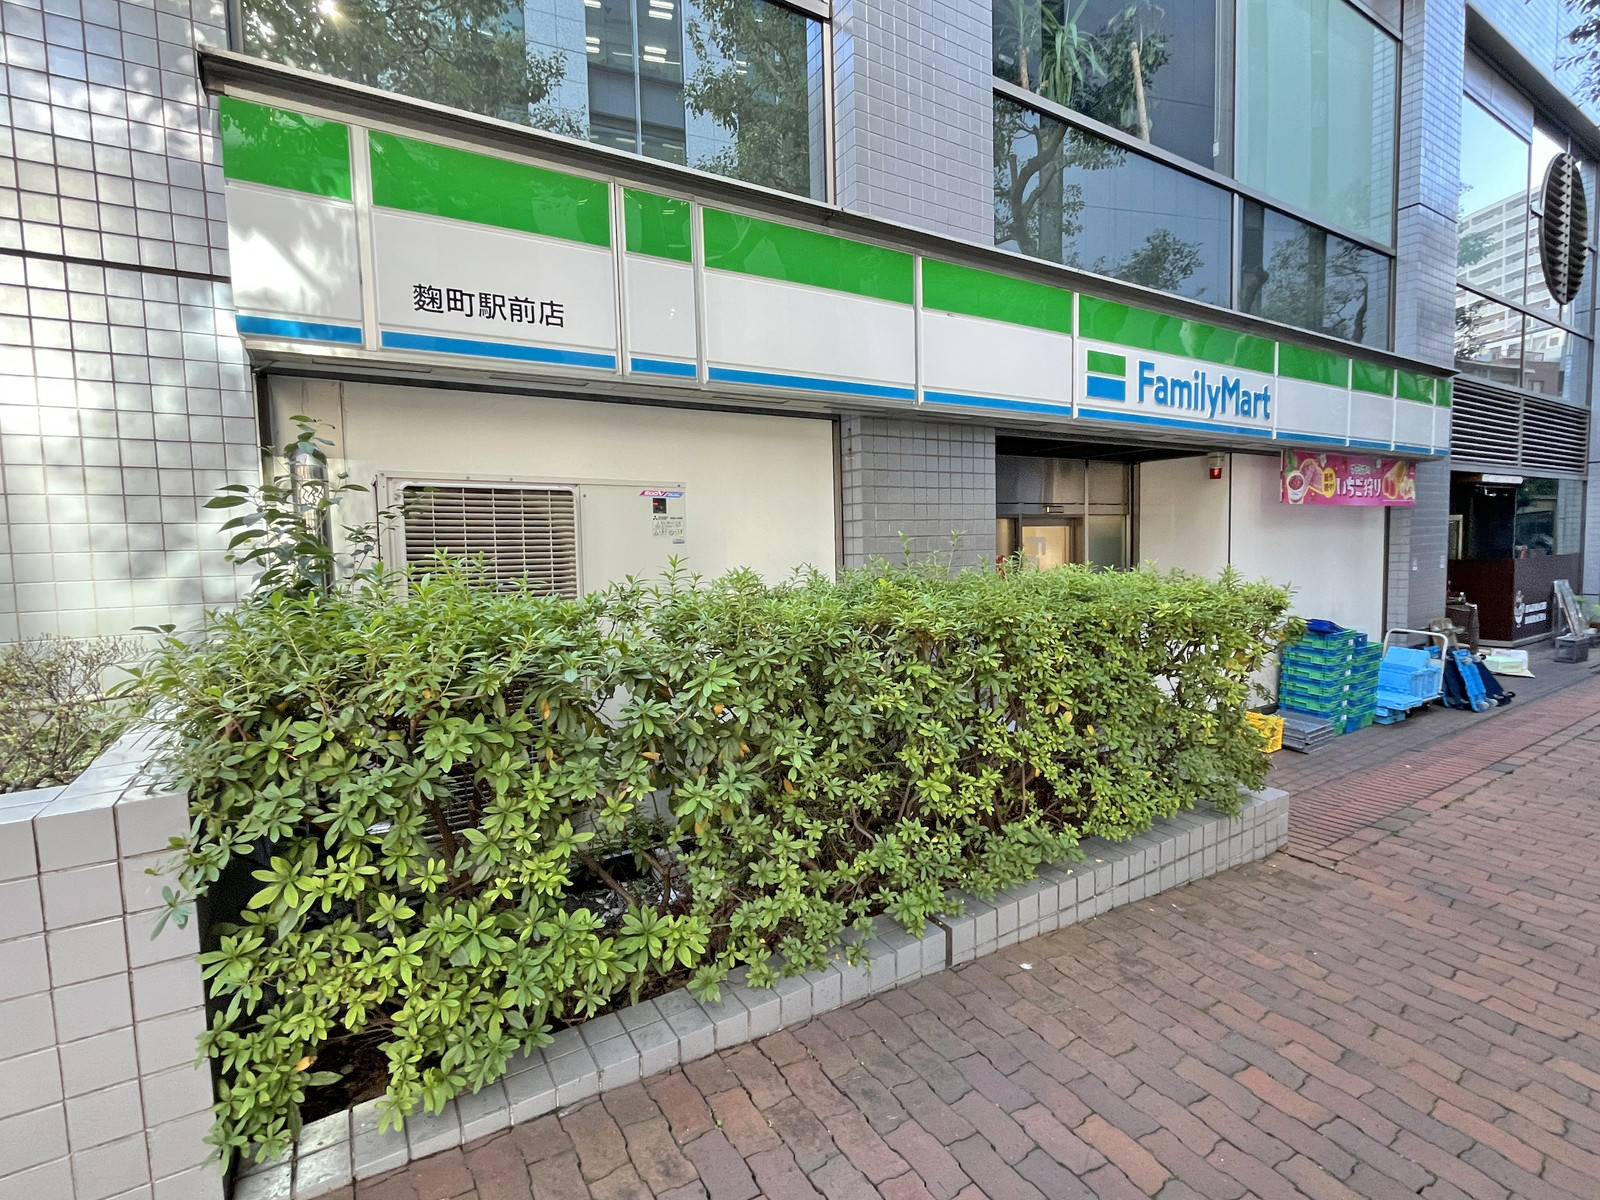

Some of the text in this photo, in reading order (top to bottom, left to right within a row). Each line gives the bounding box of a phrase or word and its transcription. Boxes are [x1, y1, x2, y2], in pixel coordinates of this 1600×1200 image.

[1137, 360, 1271, 420] FamilyMart
[1336, 476, 1382, 497] いちご狩り
